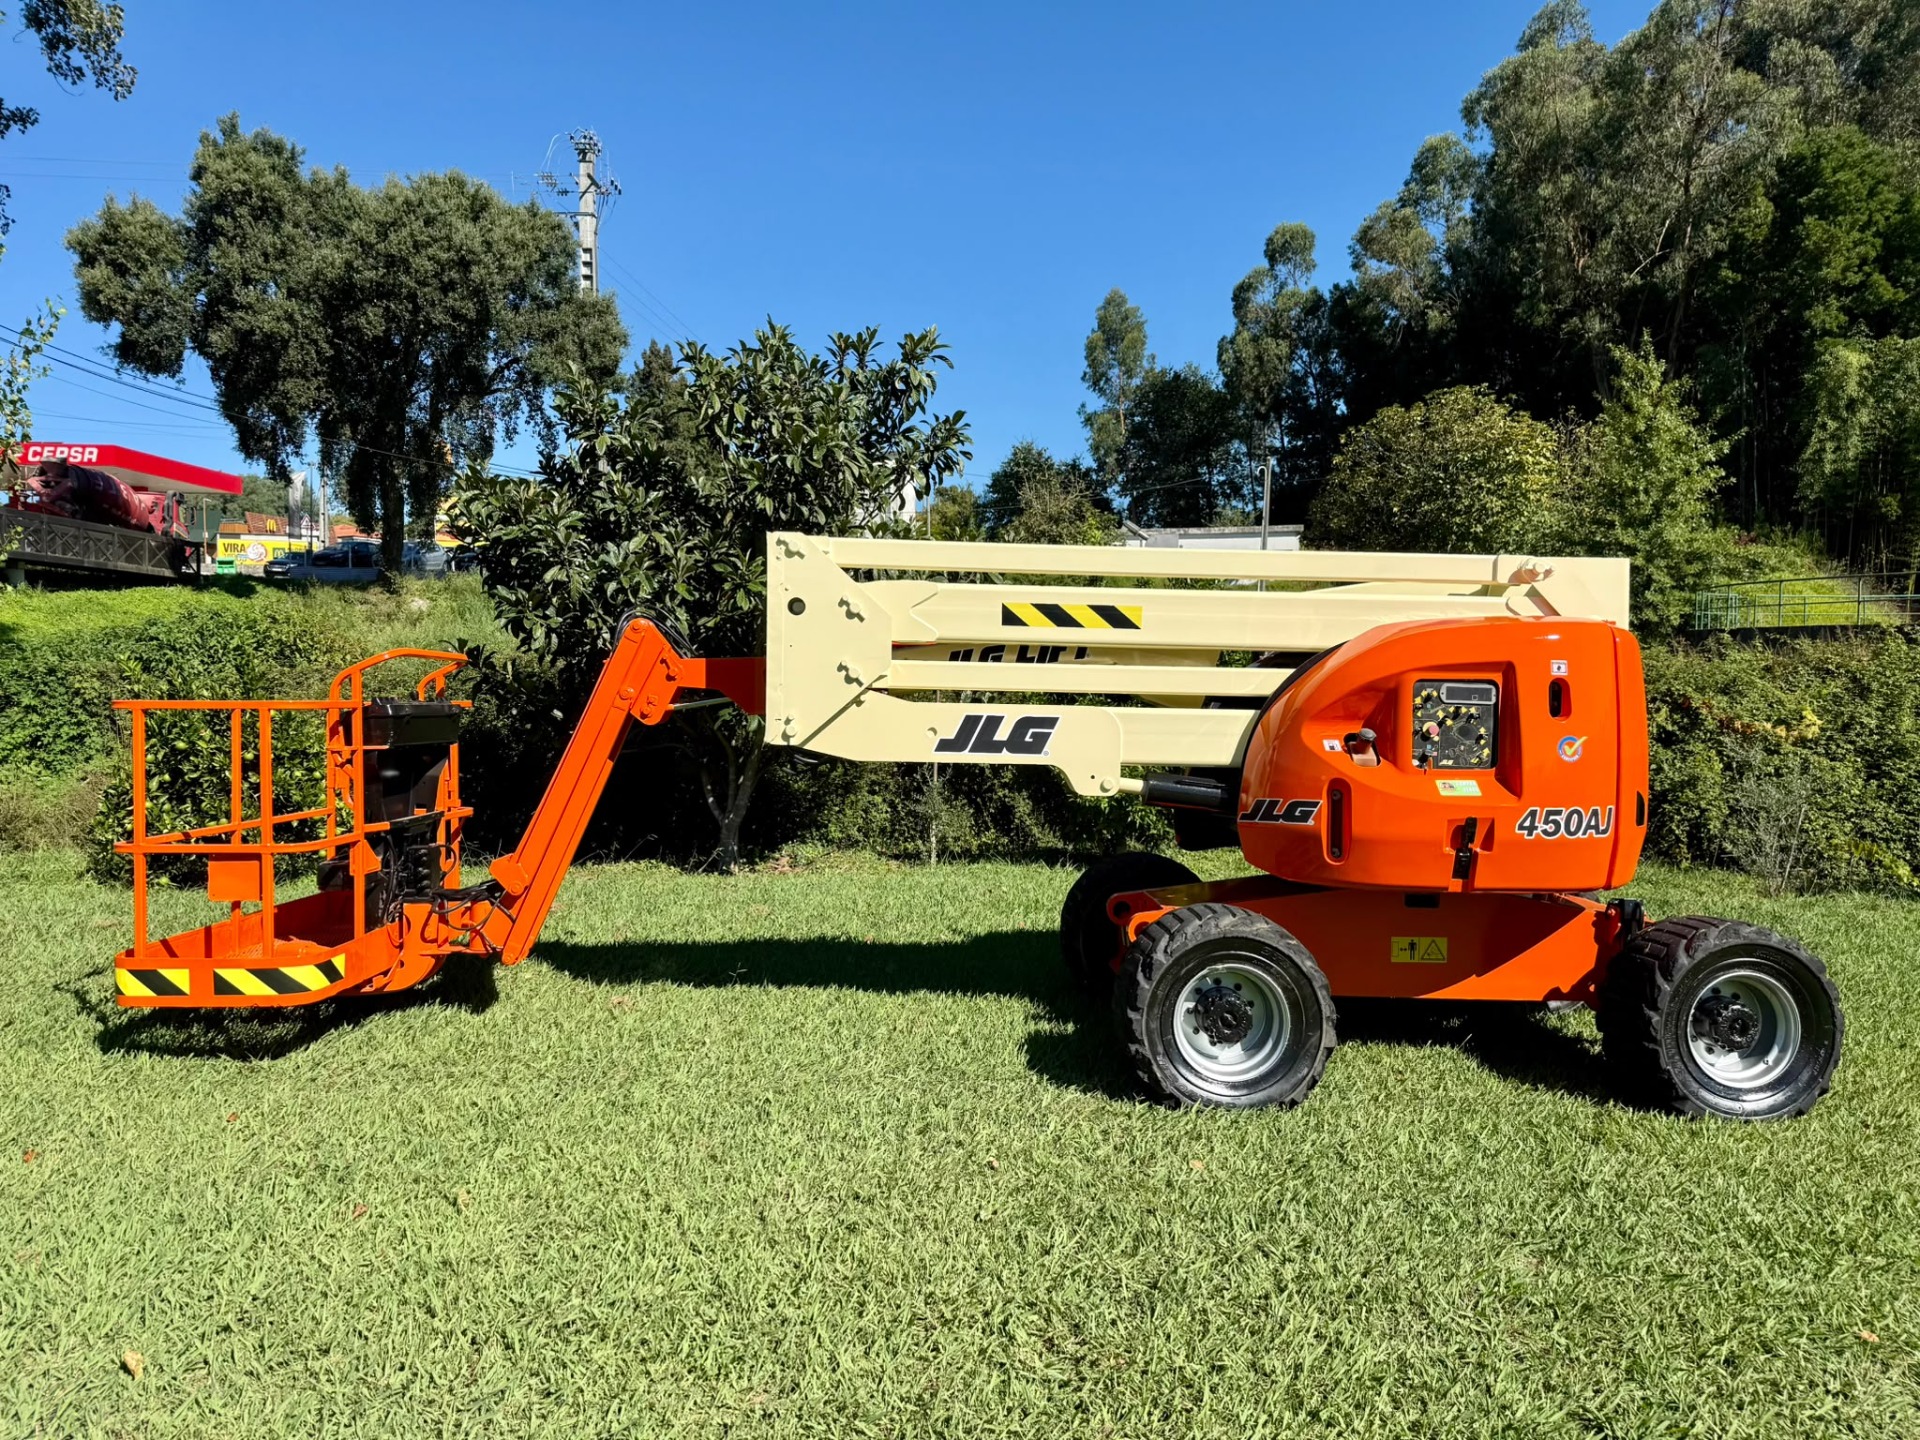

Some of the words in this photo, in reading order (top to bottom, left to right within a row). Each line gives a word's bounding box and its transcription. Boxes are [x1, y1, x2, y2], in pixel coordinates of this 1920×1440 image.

[27, 445, 99, 463] CEPSA
[222, 542, 246, 553] VIRA
[933, 714, 1060, 755] JLG
[1238, 798, 1322, 824] JLG
[1516, 806, 1613, 838] 450AJ
